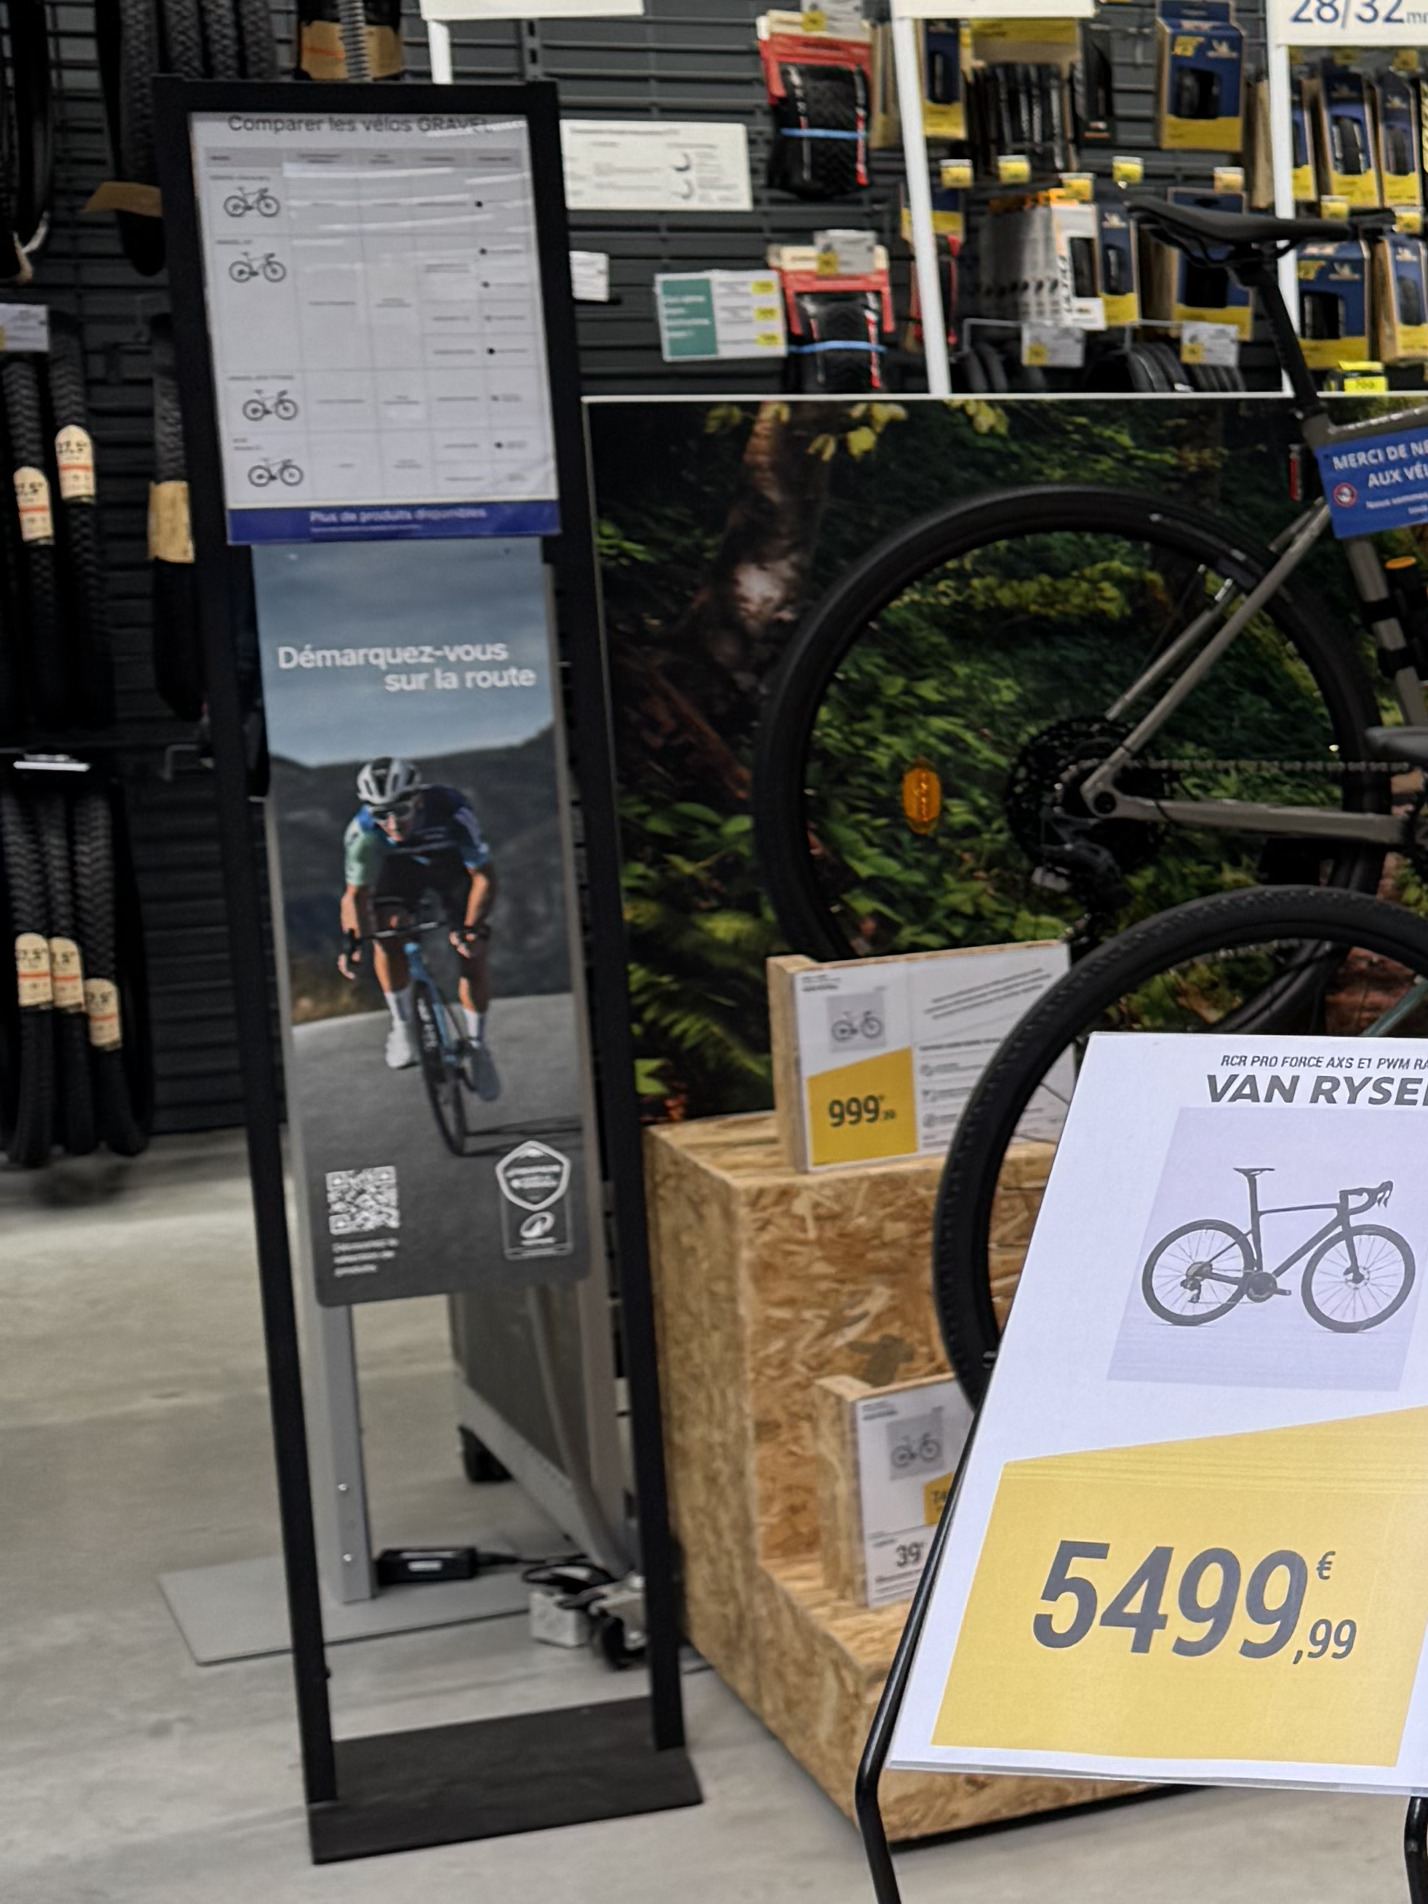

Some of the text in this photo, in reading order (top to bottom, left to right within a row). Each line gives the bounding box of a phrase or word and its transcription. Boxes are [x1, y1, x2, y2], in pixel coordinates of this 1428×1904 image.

[228, 115, 324, 135] Comparer
[328, 115, 357, 132] les
[363, 115, 412, 132] vélos
[1332, 449, 1385, 470] MERCI
[1386, 446, 1406, 461] DE
[1367, 469, 1402, 489] AUX
[309, 511, 337, 523] Plus
[340, 511, 357, 522] de
[360, 509, 412, 523] produits
[277, 643, 509, 671] Démarquez-vous
[384, 667, 537, 693] sur la route
[1220, 1055, 1248, 1066] RCR
[1250, 1055, 1278, 1067] PRO
[1281, 1056, 1324, 1068] FORCE
[1325, 1057, 1353, 1069] AXS
[1357, 1057, 1372, 1069] E1
[1376, 1058, 1410, 1070] PWM
[1207, 1074, 1300, 1103] VAN
